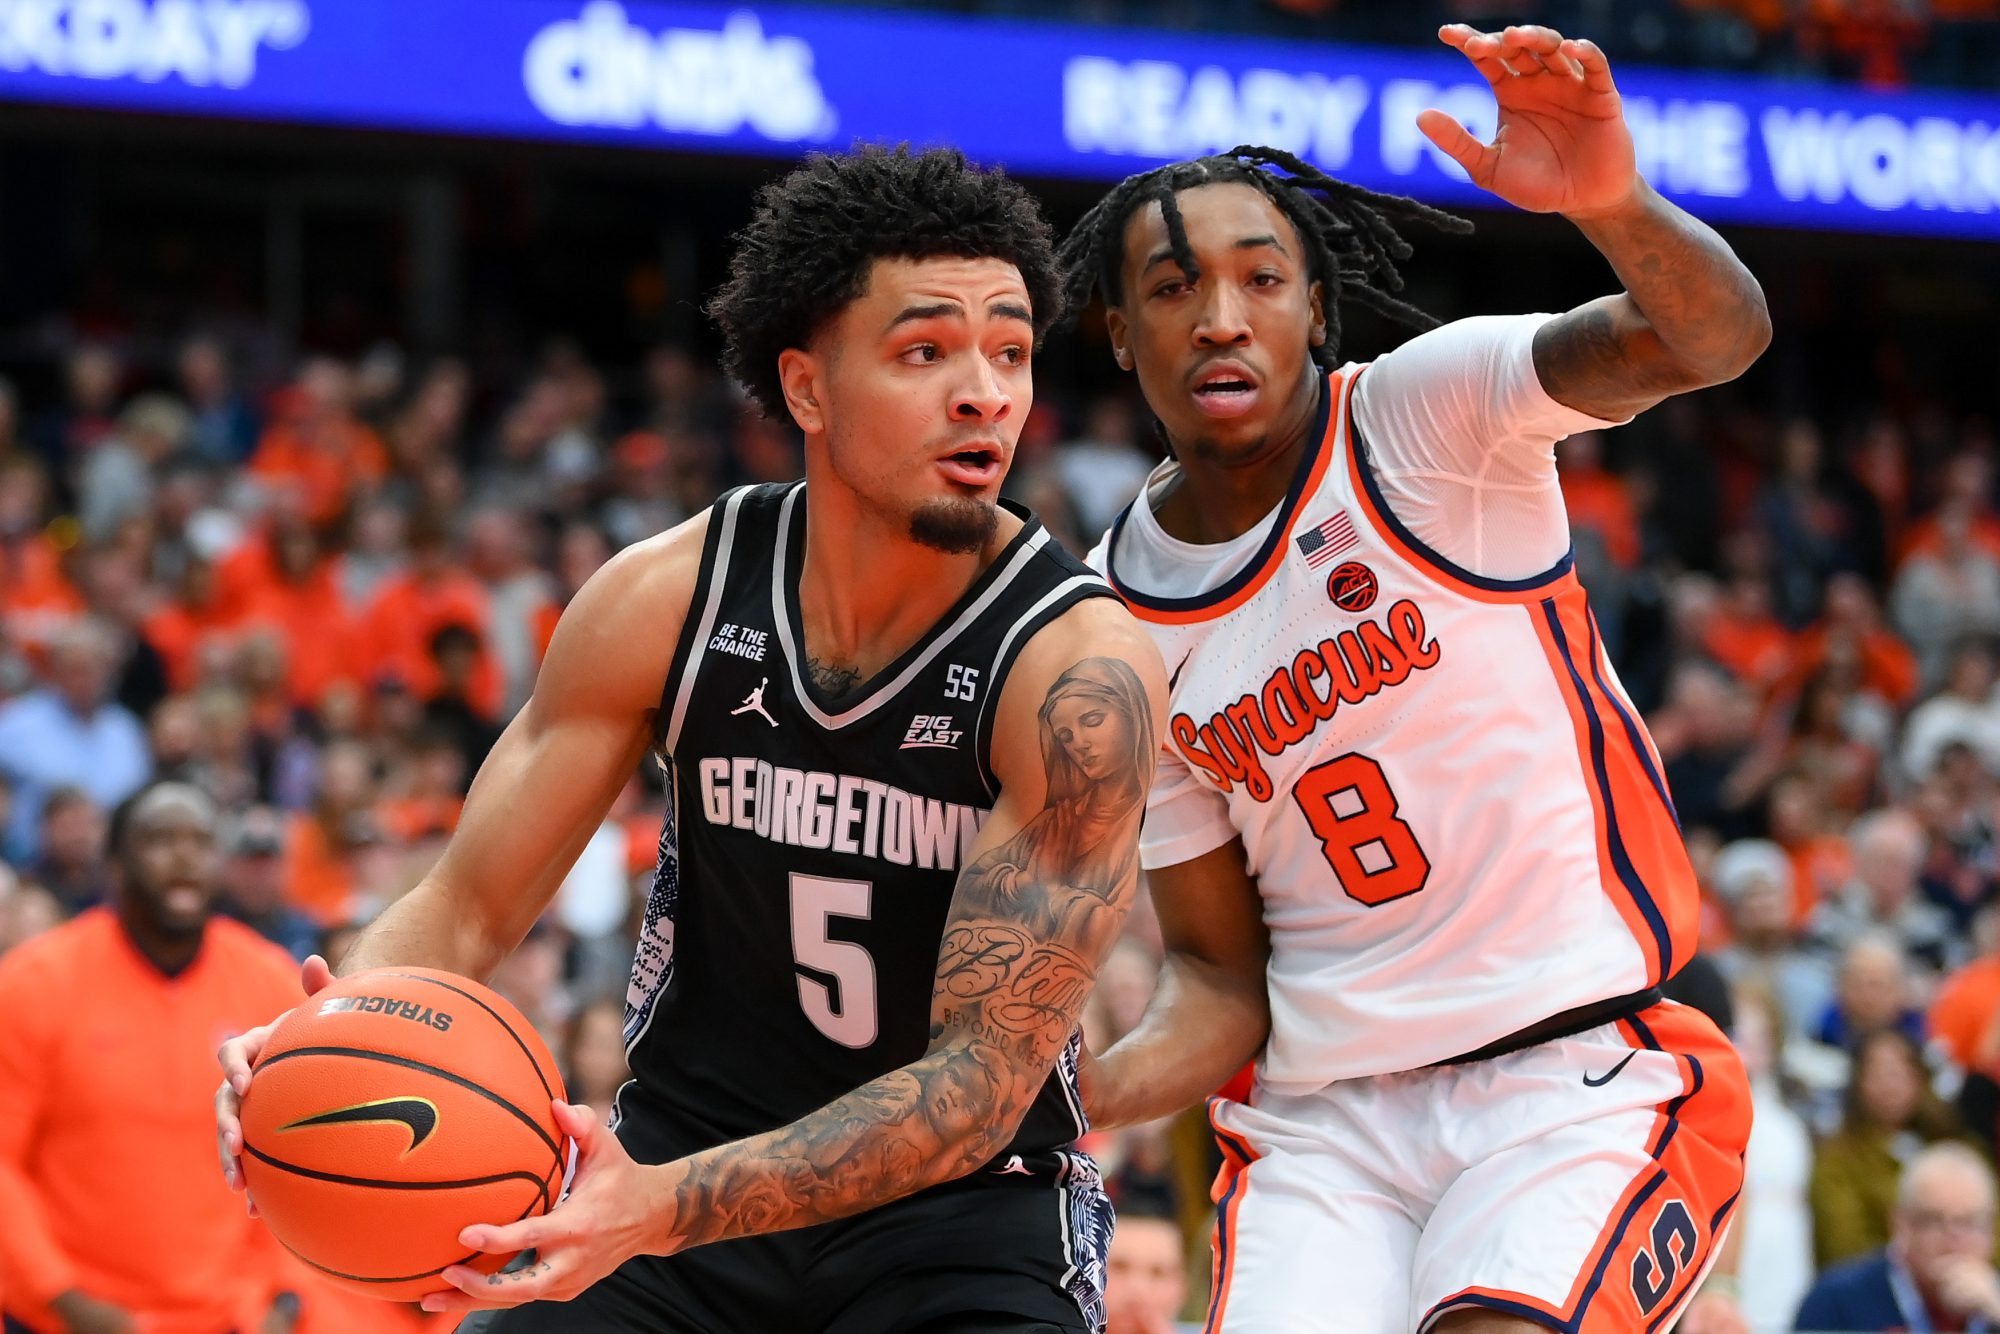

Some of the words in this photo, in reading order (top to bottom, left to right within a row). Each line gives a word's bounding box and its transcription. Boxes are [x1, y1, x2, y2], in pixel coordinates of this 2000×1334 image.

[1062, 56, 1370, 170] READY
[1380, 79, 1498, 183] FO
[1620, 95, 1748, 198] HE
[709, 636, 767, 661] CHANGE
[719, 623, 739, 638] BE
[740, 627, 768, 646] THE
[903, 729, 964, 744] EAST
[910, 714, 953, 730] BIG
[1170, 599, 1440, 802] Syracuse
[1292, 751, 1431, 908] 8
[788, 871, 878, 1050] 5
[1629, 1198, 1699, 1320] S
